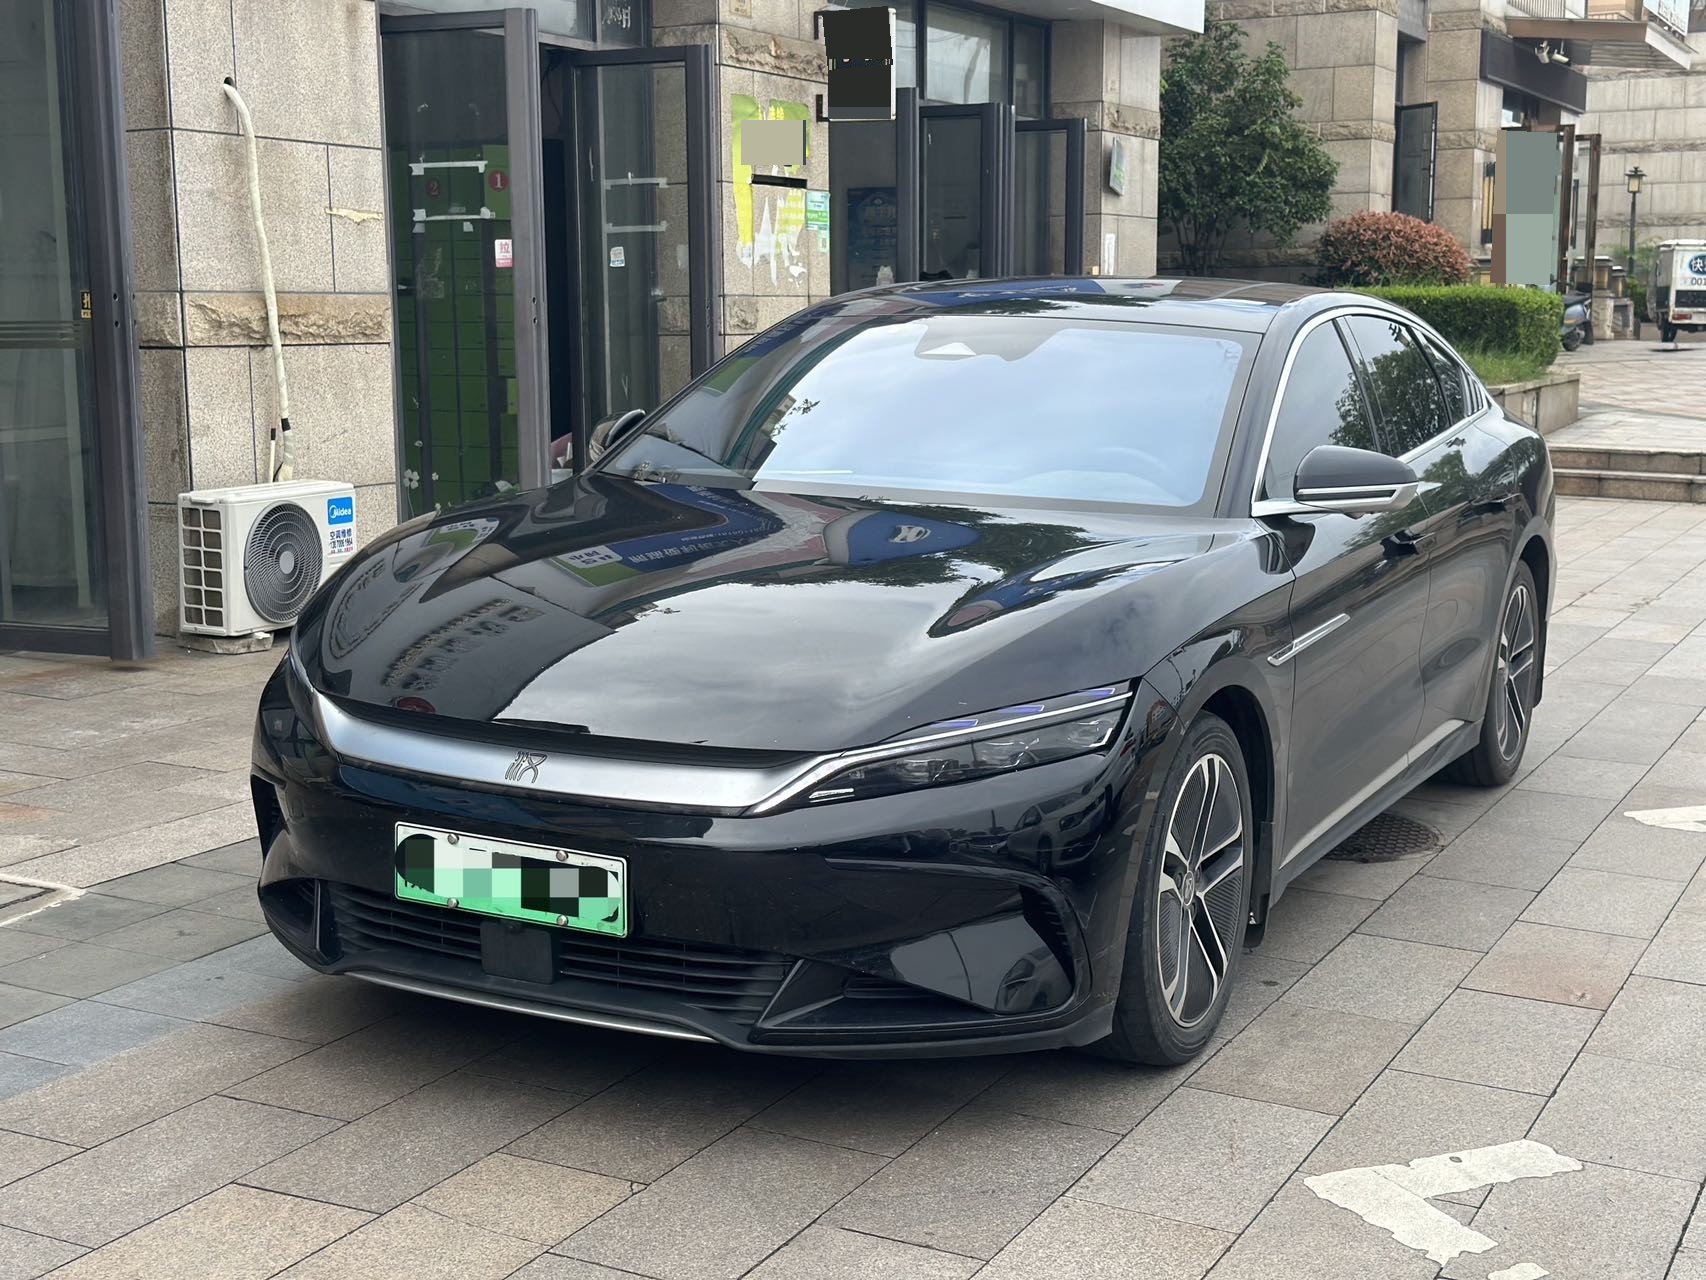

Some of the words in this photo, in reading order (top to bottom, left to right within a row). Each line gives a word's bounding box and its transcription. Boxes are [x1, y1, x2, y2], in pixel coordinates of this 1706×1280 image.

[495, 174, 502, 189] 1
[430, 182, 438, 196] 2
[1691, 257, 1706, 272] 快
[329, 505, 352, 519] Midea
